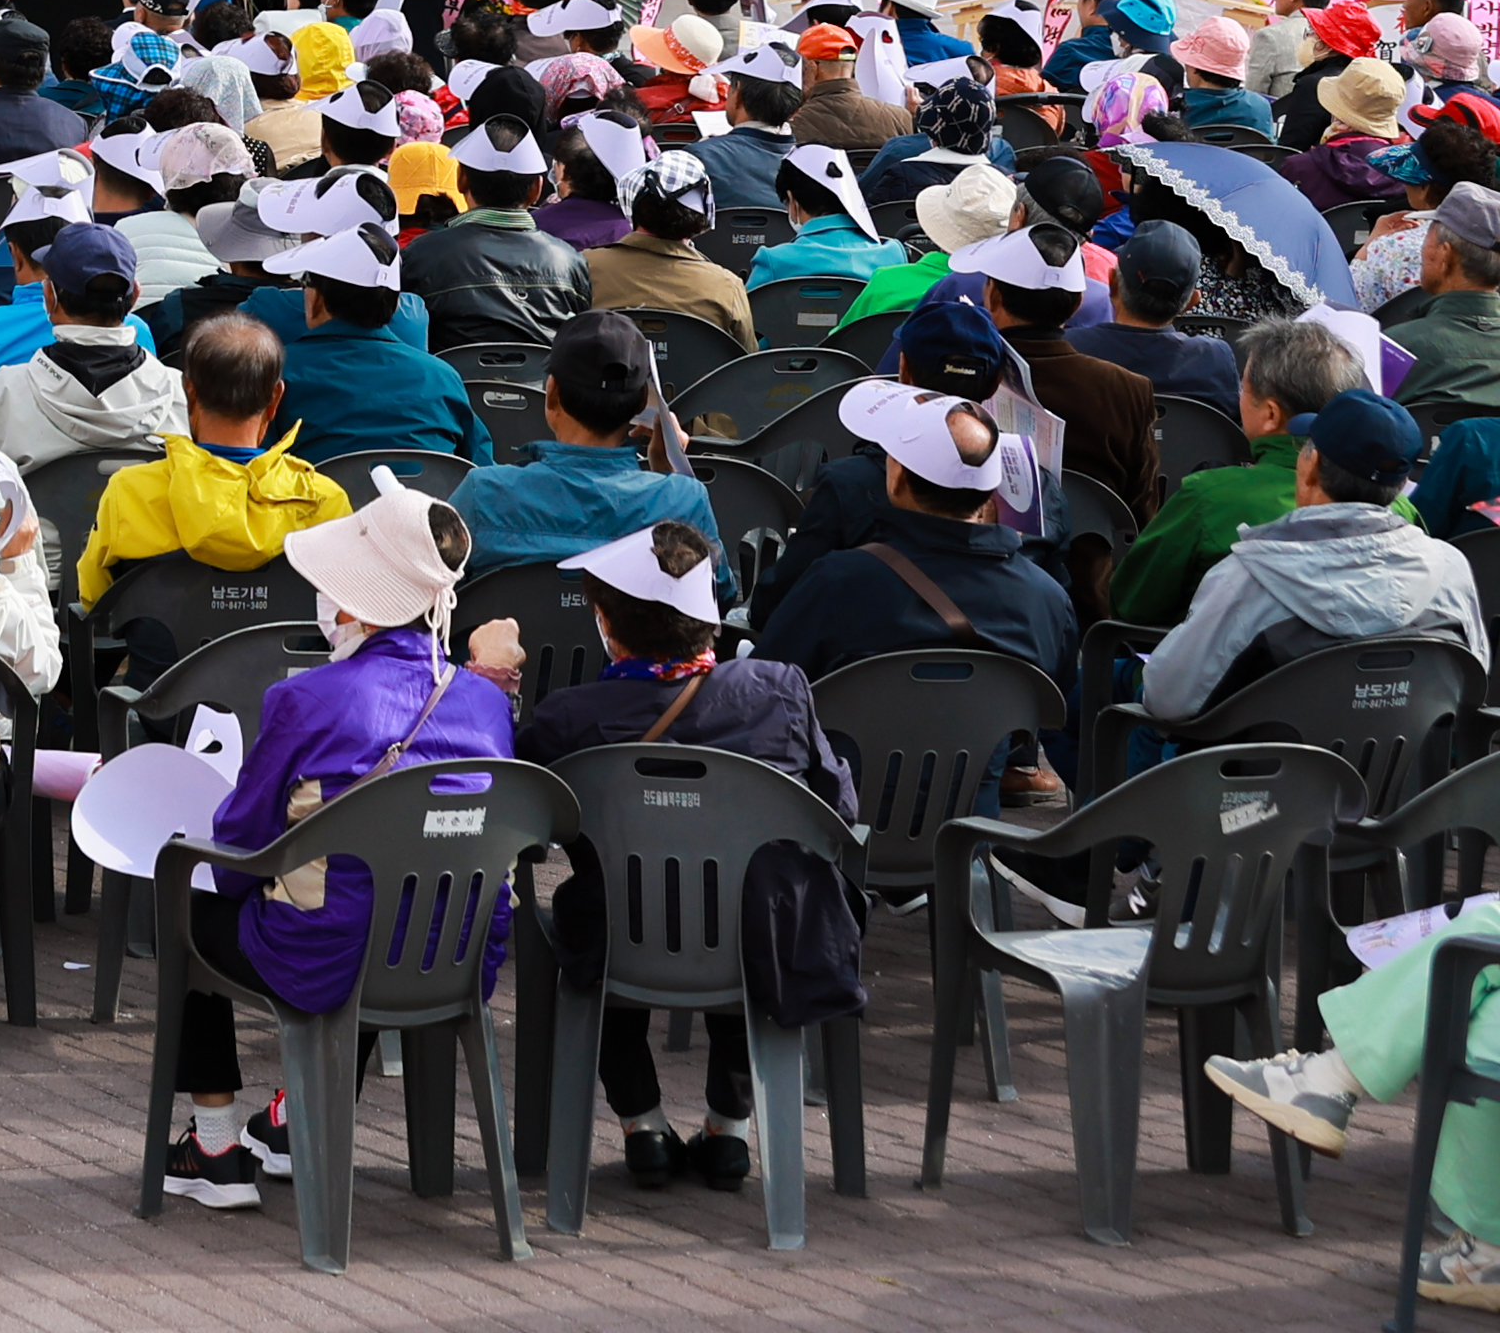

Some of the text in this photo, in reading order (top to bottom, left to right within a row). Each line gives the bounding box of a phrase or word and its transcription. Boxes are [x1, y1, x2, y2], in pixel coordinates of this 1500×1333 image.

[211, 586, 269, 600] 남도기획
[211, 600, 269, 610] 010-8471-3400
[1354, 680, 1410, 699] 남도기획
[1351, 696, 1407, 710] 010-8471-3400
